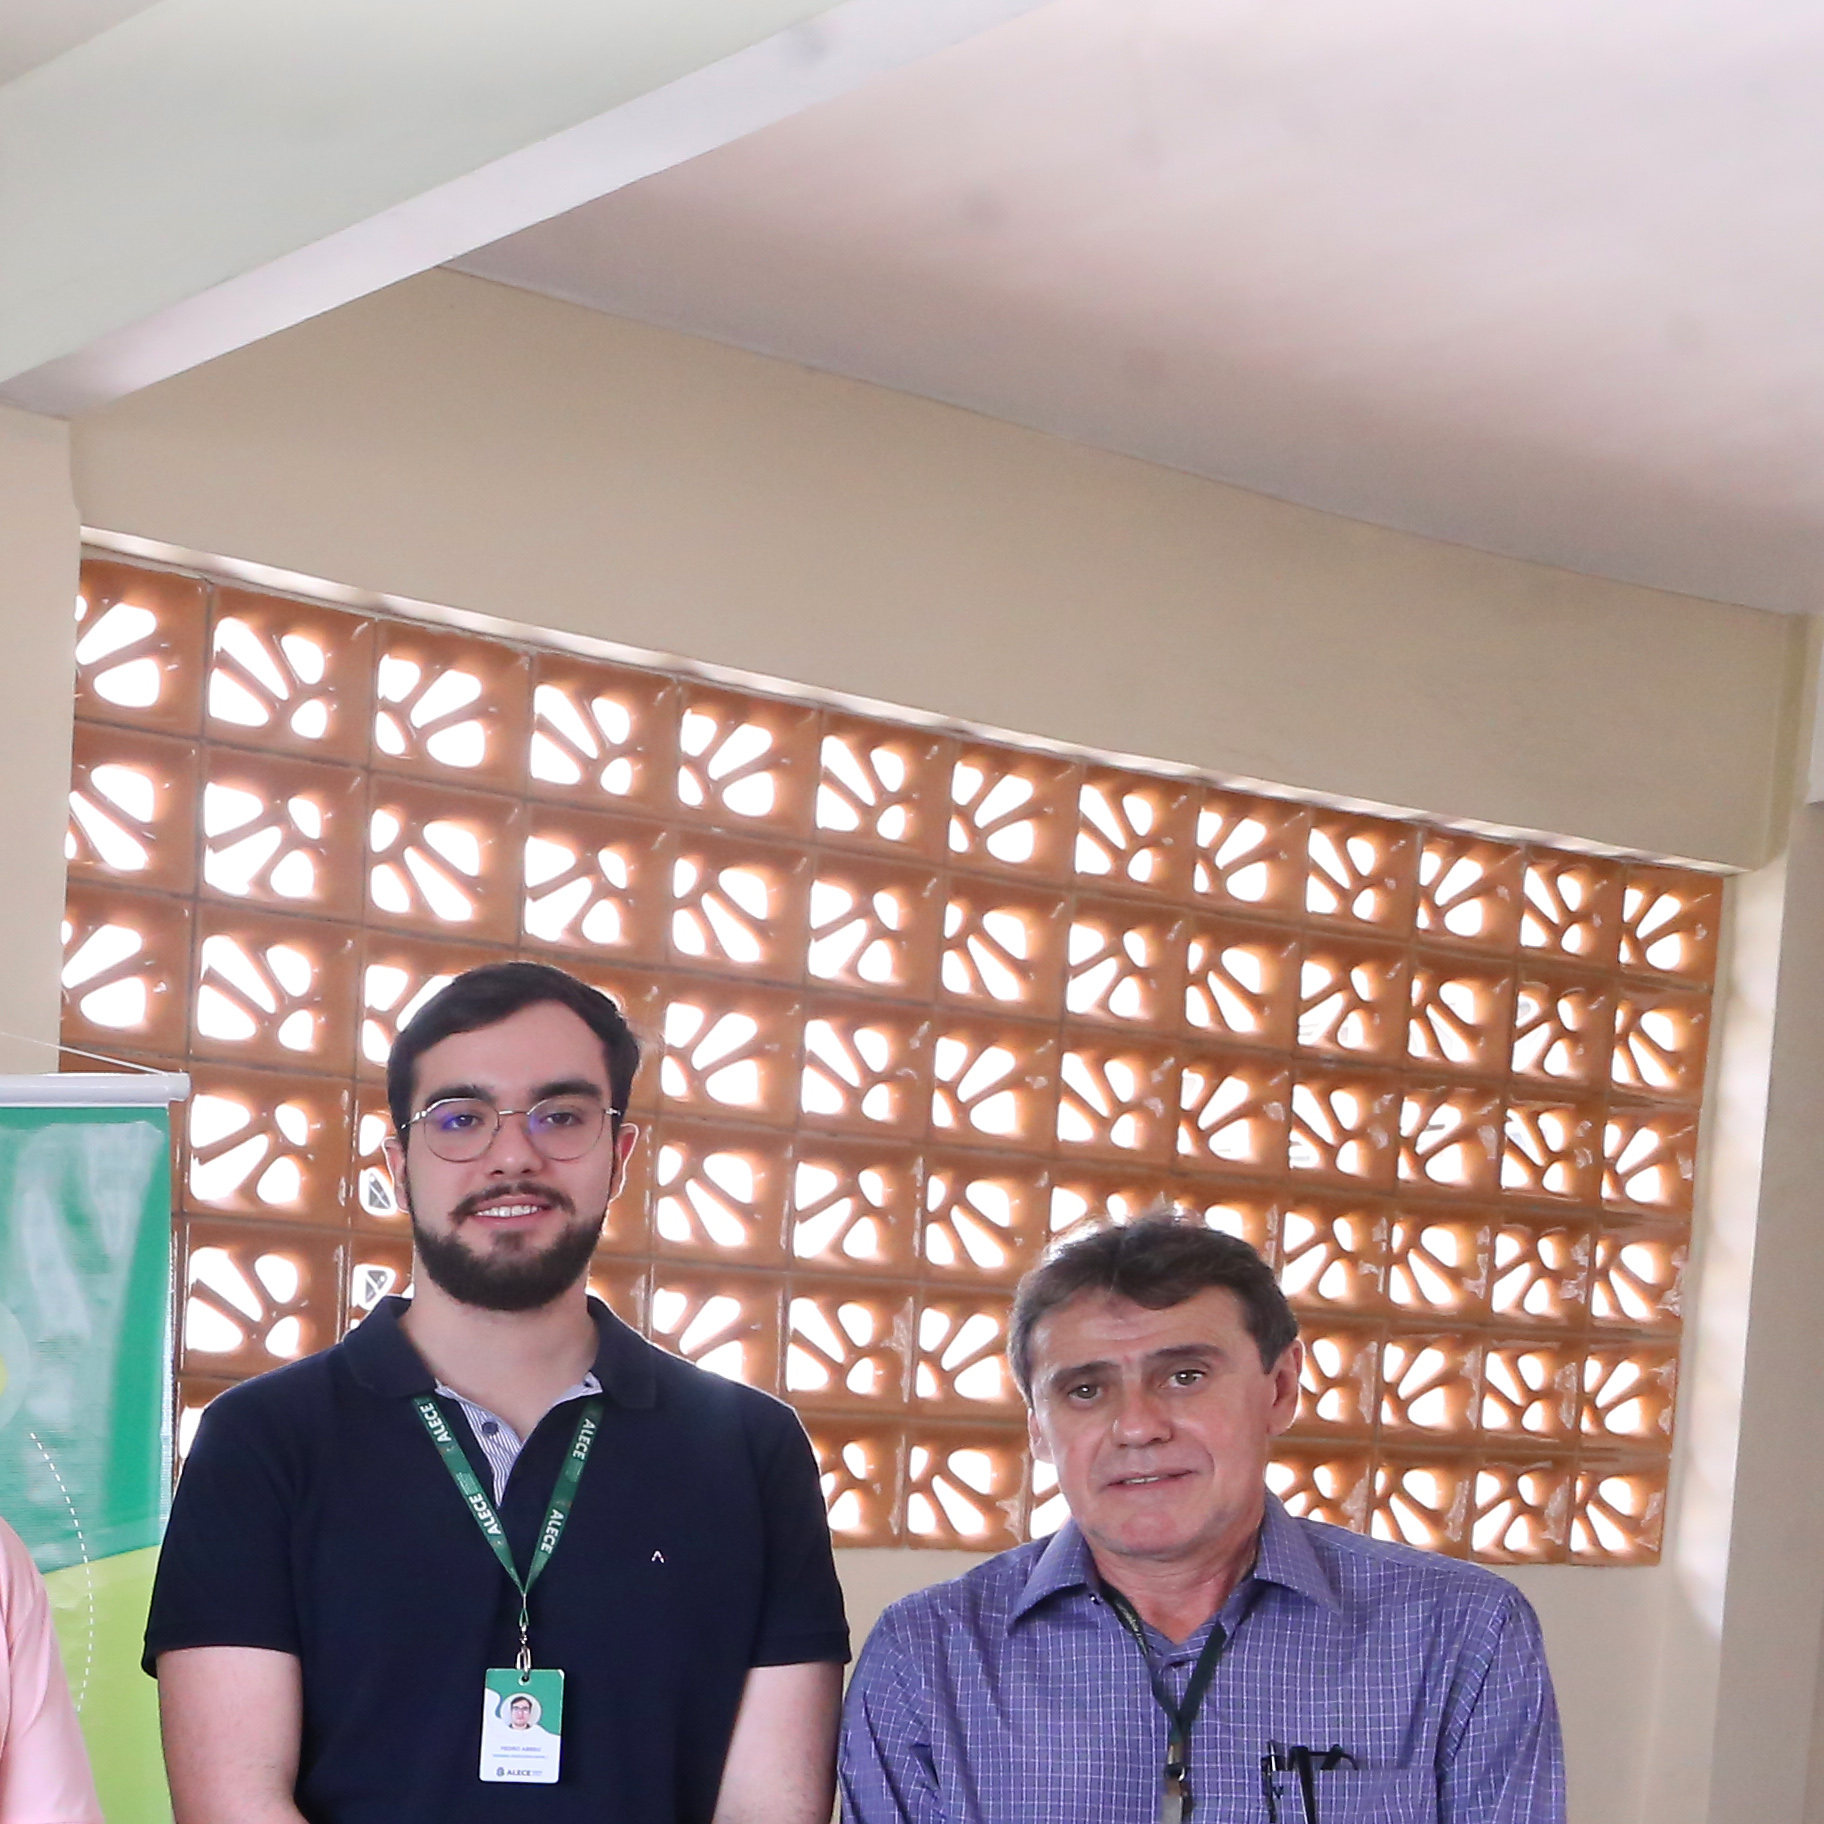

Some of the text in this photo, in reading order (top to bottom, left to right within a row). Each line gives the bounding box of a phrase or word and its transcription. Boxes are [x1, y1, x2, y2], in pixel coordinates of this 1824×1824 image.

[419, 1402, 452, 1443] ALECE
[572, 1418, 598, 1461] ALECE
[468, 1492, 502, 1536] ALECE
[540, 1509, 566, 1555] ALECE
